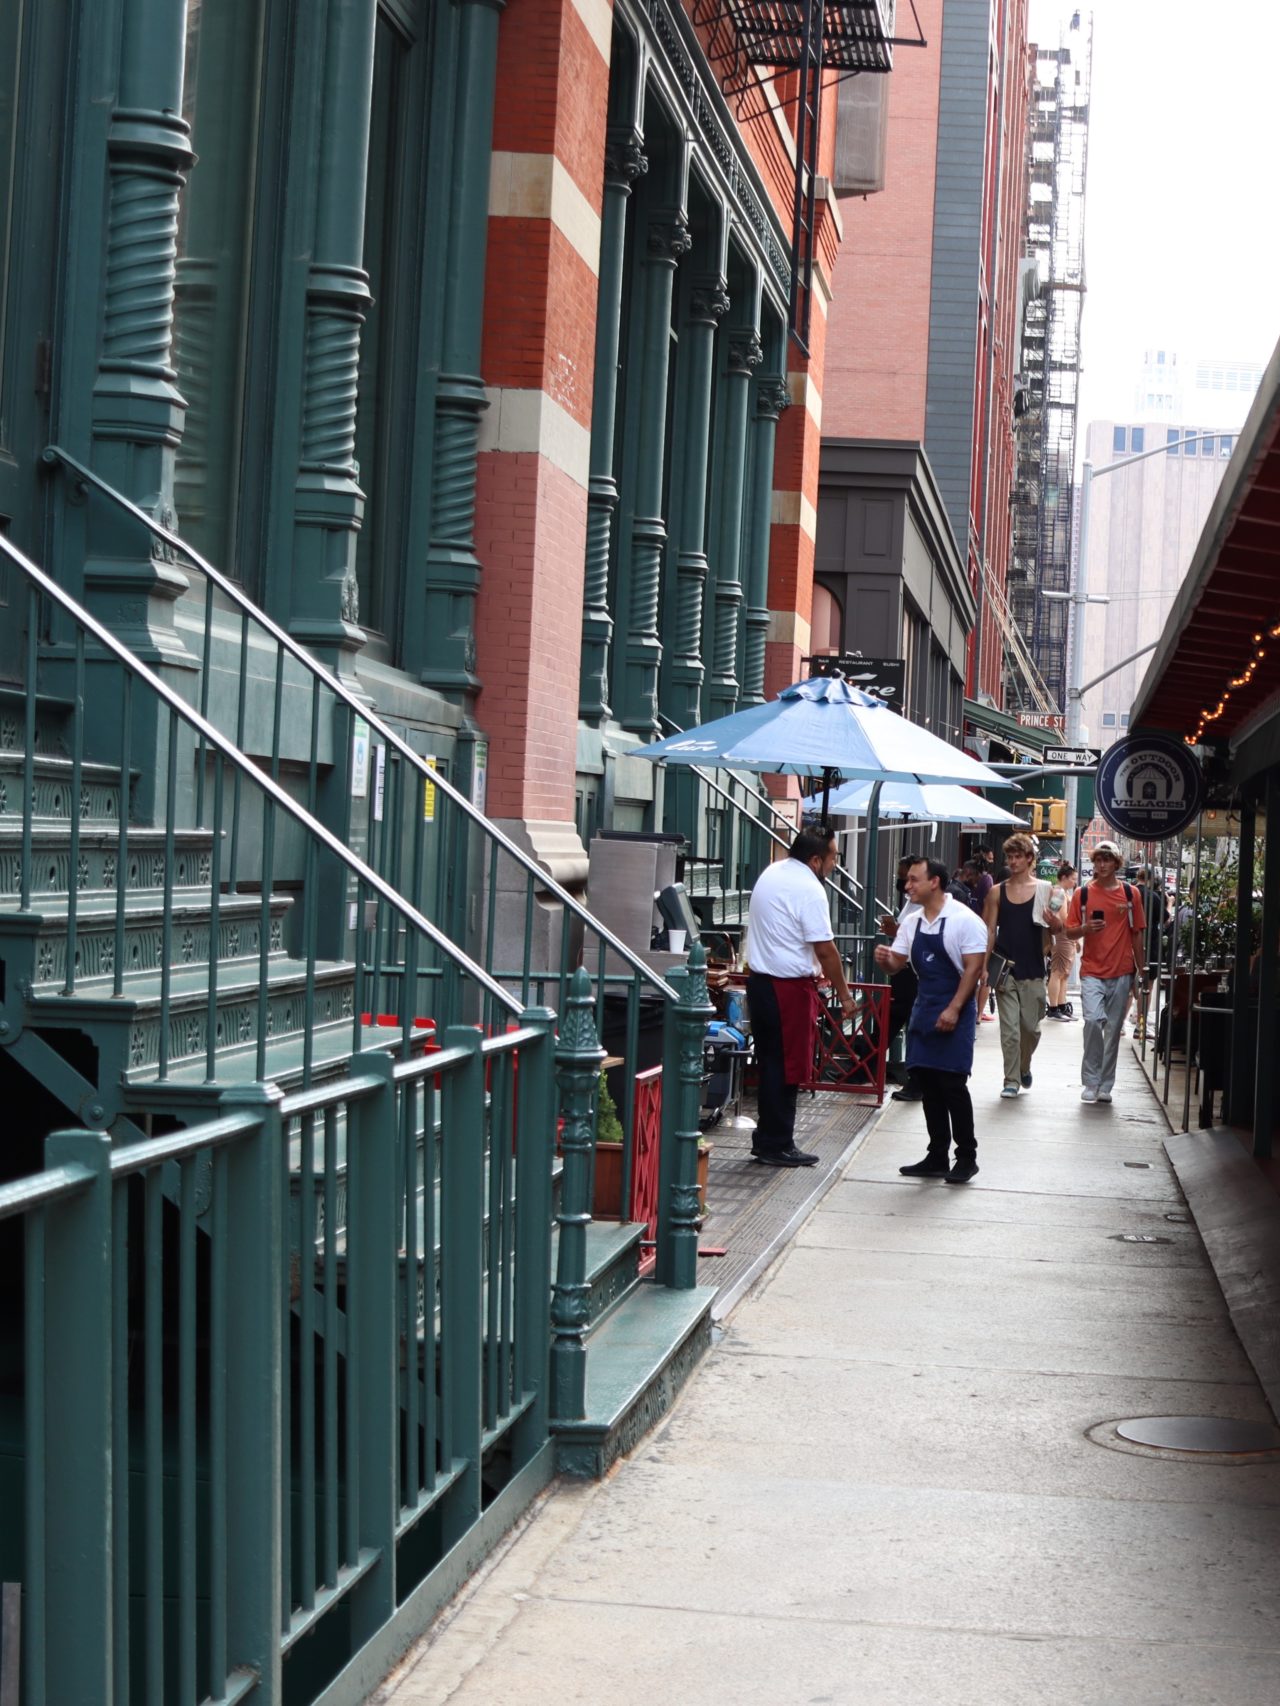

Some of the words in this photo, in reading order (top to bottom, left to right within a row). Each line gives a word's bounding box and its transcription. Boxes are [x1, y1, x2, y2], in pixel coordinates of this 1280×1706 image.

[1020, 714, 1049, 727] PRINCE
[1053, 715, 1063, 728] ST
[1051, 751, 1068, 760] ONE
[1075, 752, 1093, 762] WAY
[1130, 754, 1181, 783] OUTDOOR
[1113, 799, 1185, 809] VILLAGES
